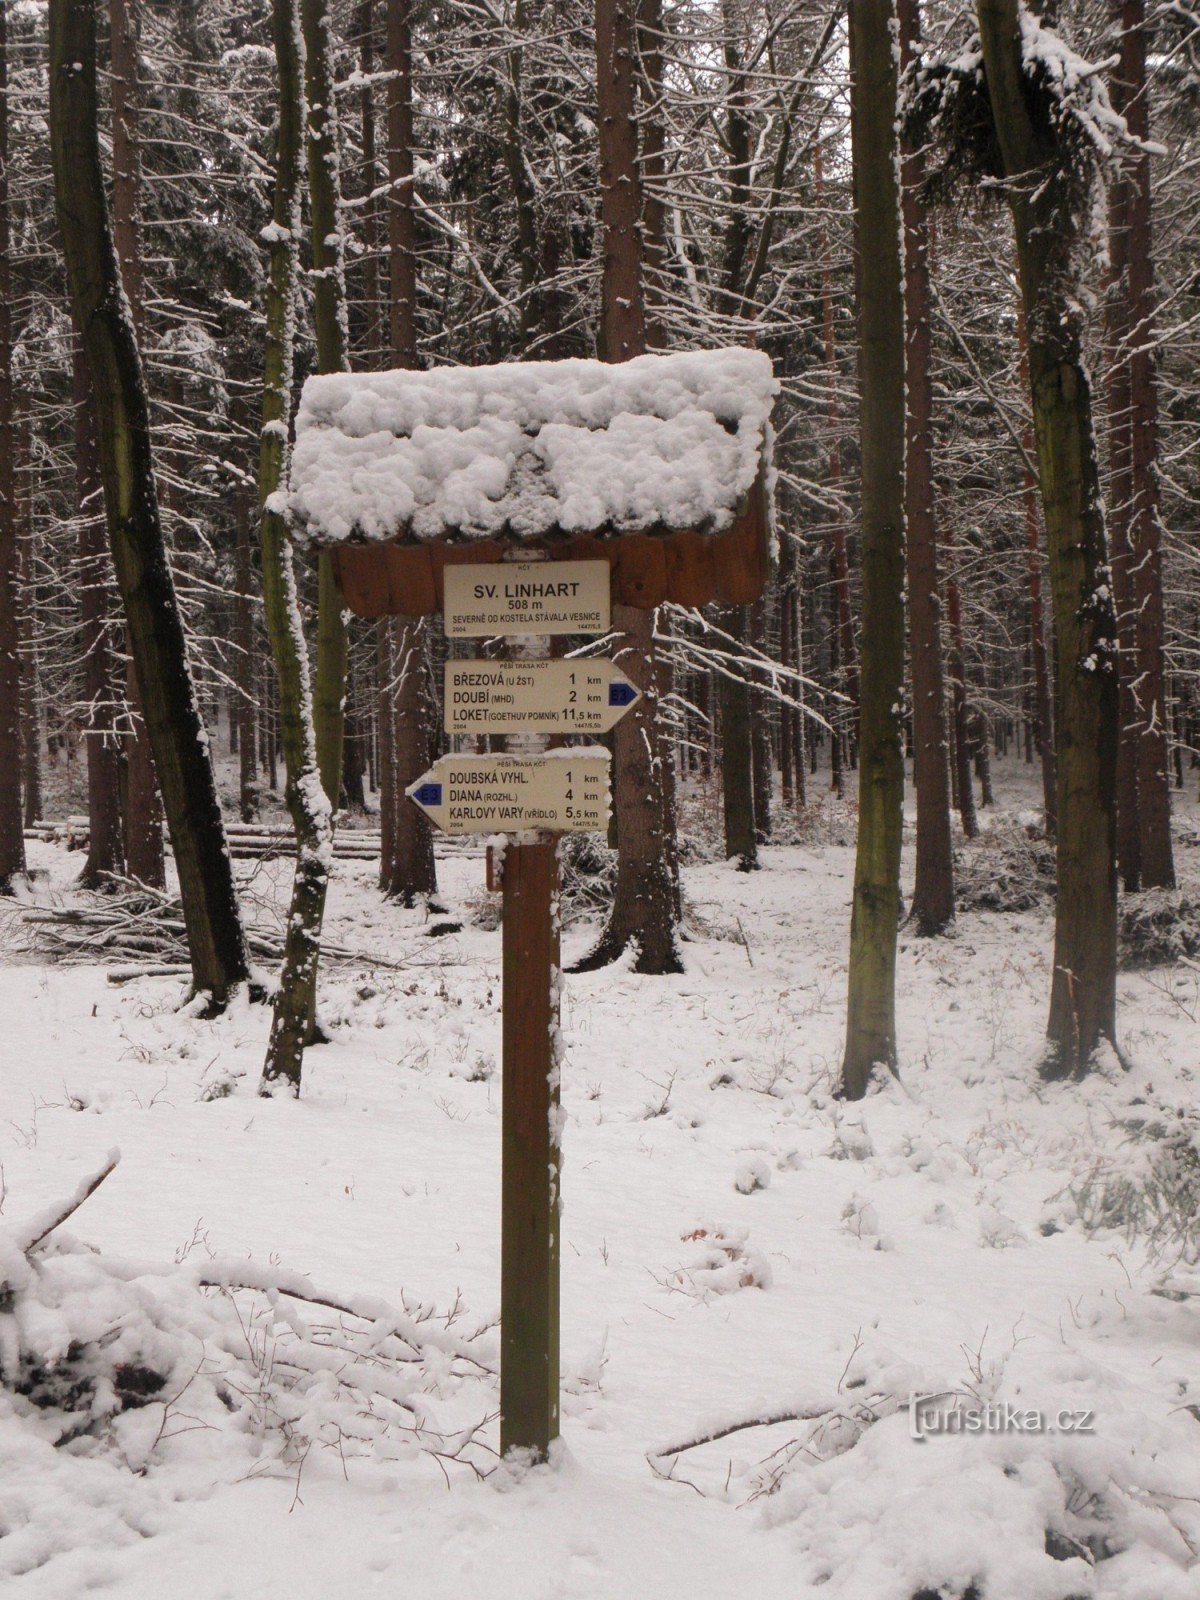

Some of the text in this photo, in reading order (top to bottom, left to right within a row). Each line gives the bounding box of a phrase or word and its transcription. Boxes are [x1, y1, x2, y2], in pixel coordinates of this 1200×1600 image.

[474, 583, 580, 599] SV. LINHART
[508, 600, 543, 610] 508 m
[453, 611, 601, 624] SEVERNĚ OD KOSTELA STÁVALA VESNICE
[453, 672, 602, 687] BŘEZOVÁ (U ŽST) 1 km
[453, 689, 602, 704] DOUBÍ (MHD) 2 km
[528, 710, 559, 721] POMNÍK)
[561, 709, 585, 721] 11,5
[587, 711, 602, 720] km
[450, 769, 599, 784] DOUBSKÁ VYHL. 1 km
[450, 789, 598, 803] DIANA (ROZHL.) 4 km
[450, 806, 599, 820] KARLOVY VARY (VŘÍDLO) 5,5 km
